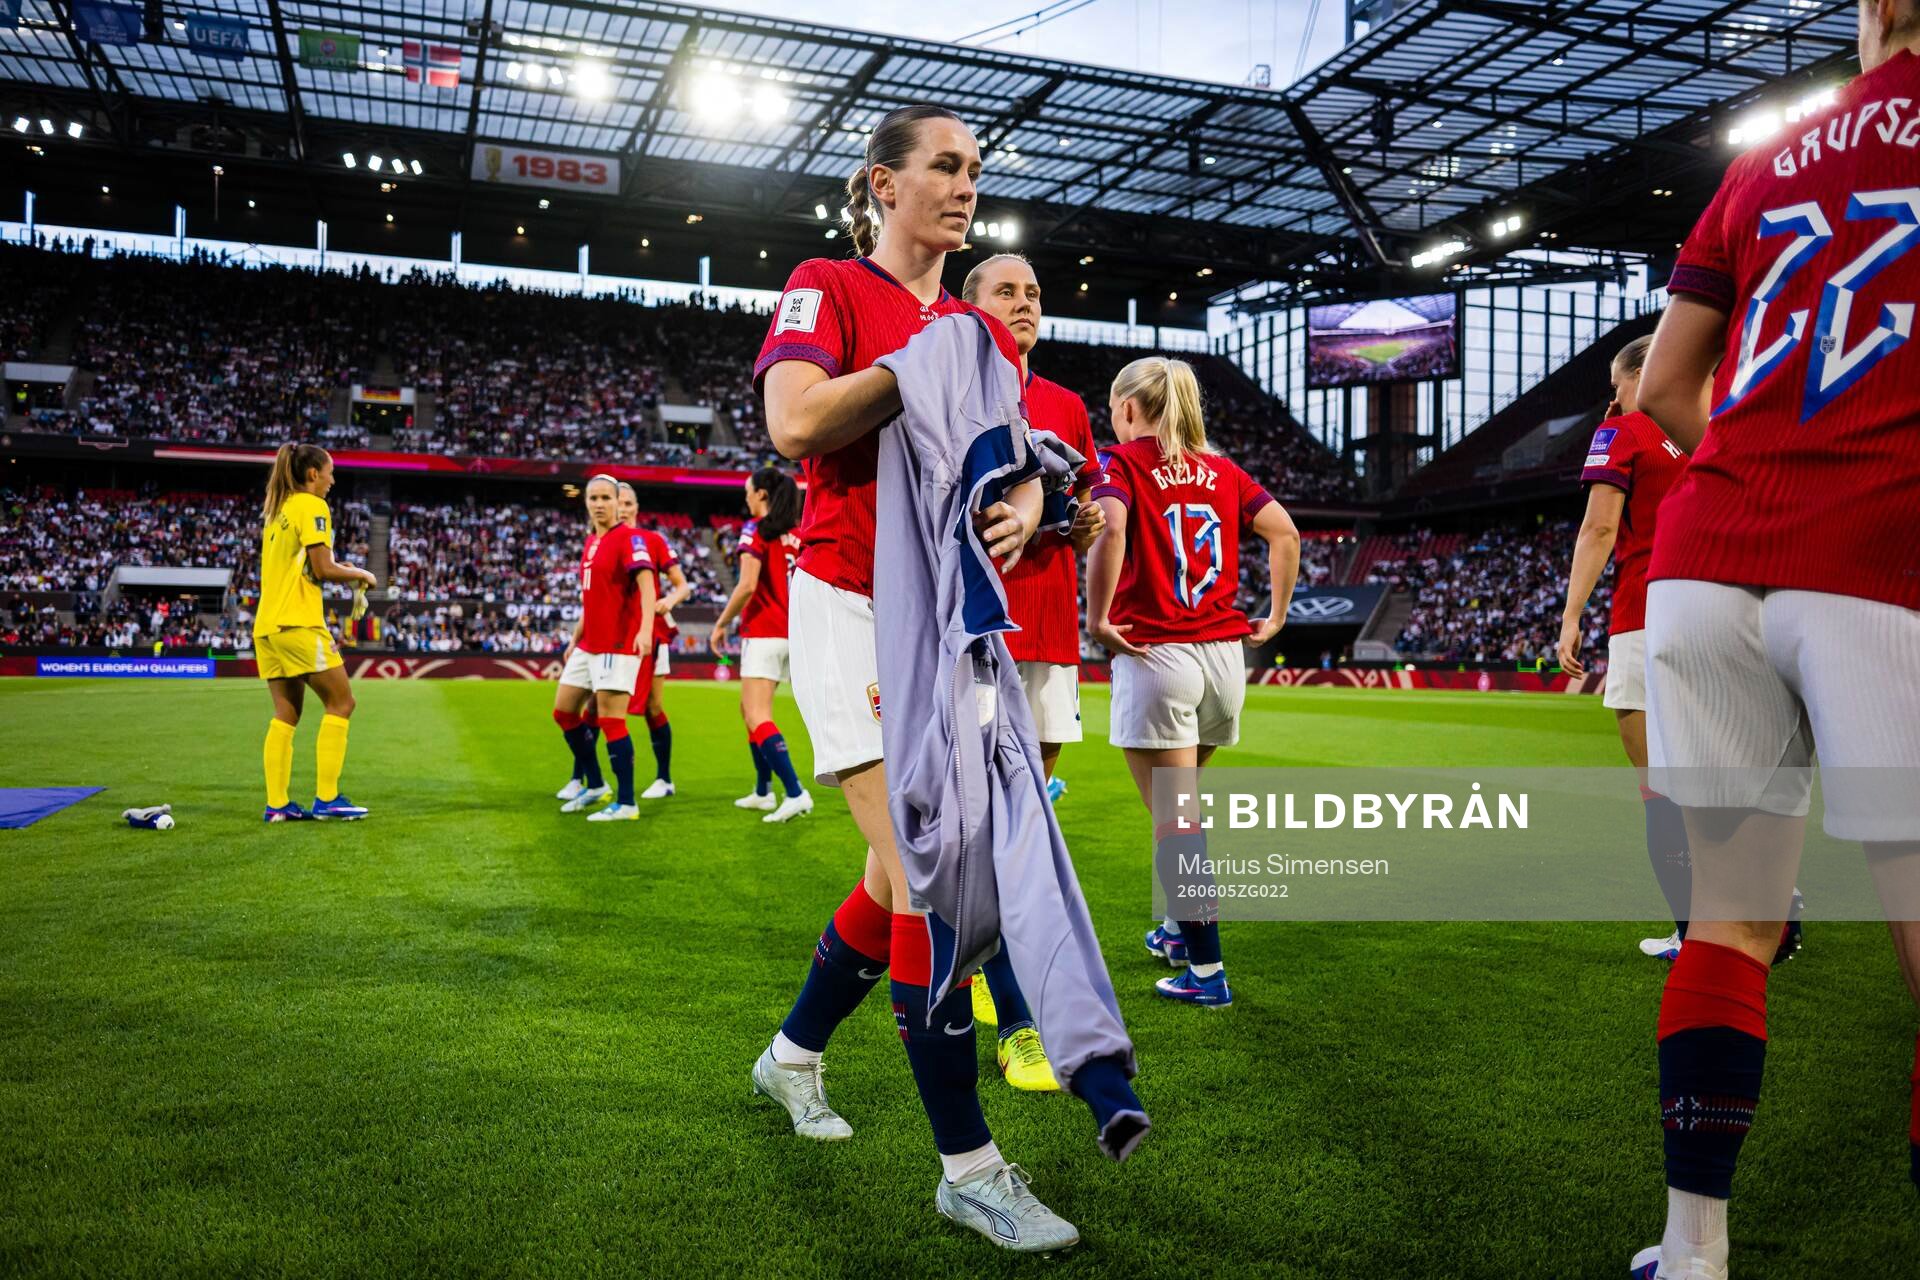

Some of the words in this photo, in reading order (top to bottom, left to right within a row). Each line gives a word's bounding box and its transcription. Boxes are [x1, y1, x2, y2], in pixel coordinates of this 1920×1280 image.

[193, 28, 244, 49] UEFA
[513, 154, 608, 185] 1983
[1708, 187, 1920, 425] 22
[1151, 463, 1218, 491] BJELDE
[1163, 503, 1223, 609] 13
[41, 663, 90, 673] WOMEN'S
[93, 663, 149, 673] EUROPEAN
[150, 664, 208, 674] QUALIFIERS
